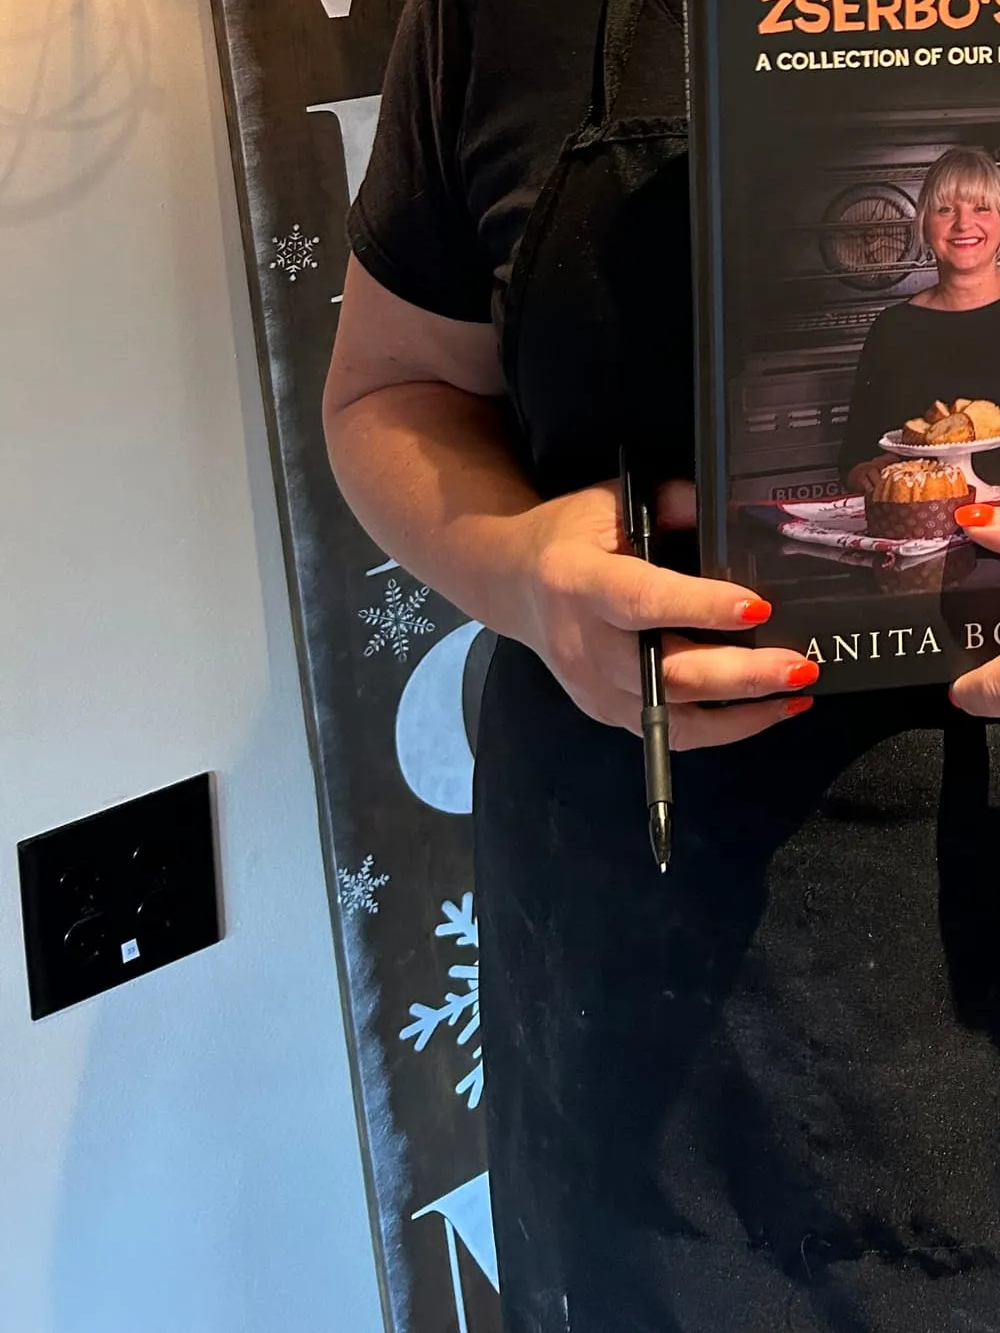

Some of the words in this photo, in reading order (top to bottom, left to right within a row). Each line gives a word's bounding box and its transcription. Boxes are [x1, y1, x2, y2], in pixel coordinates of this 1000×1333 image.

[755, 53, 772, 72] A
[776, 48, 910, 70] COLLECTION
[914, 47, 943, 66] OF
[948, 46, 993, 64] OUR
[775, 482, 846, 501] BLODG
[804, 625, 943, 665] ANITA
